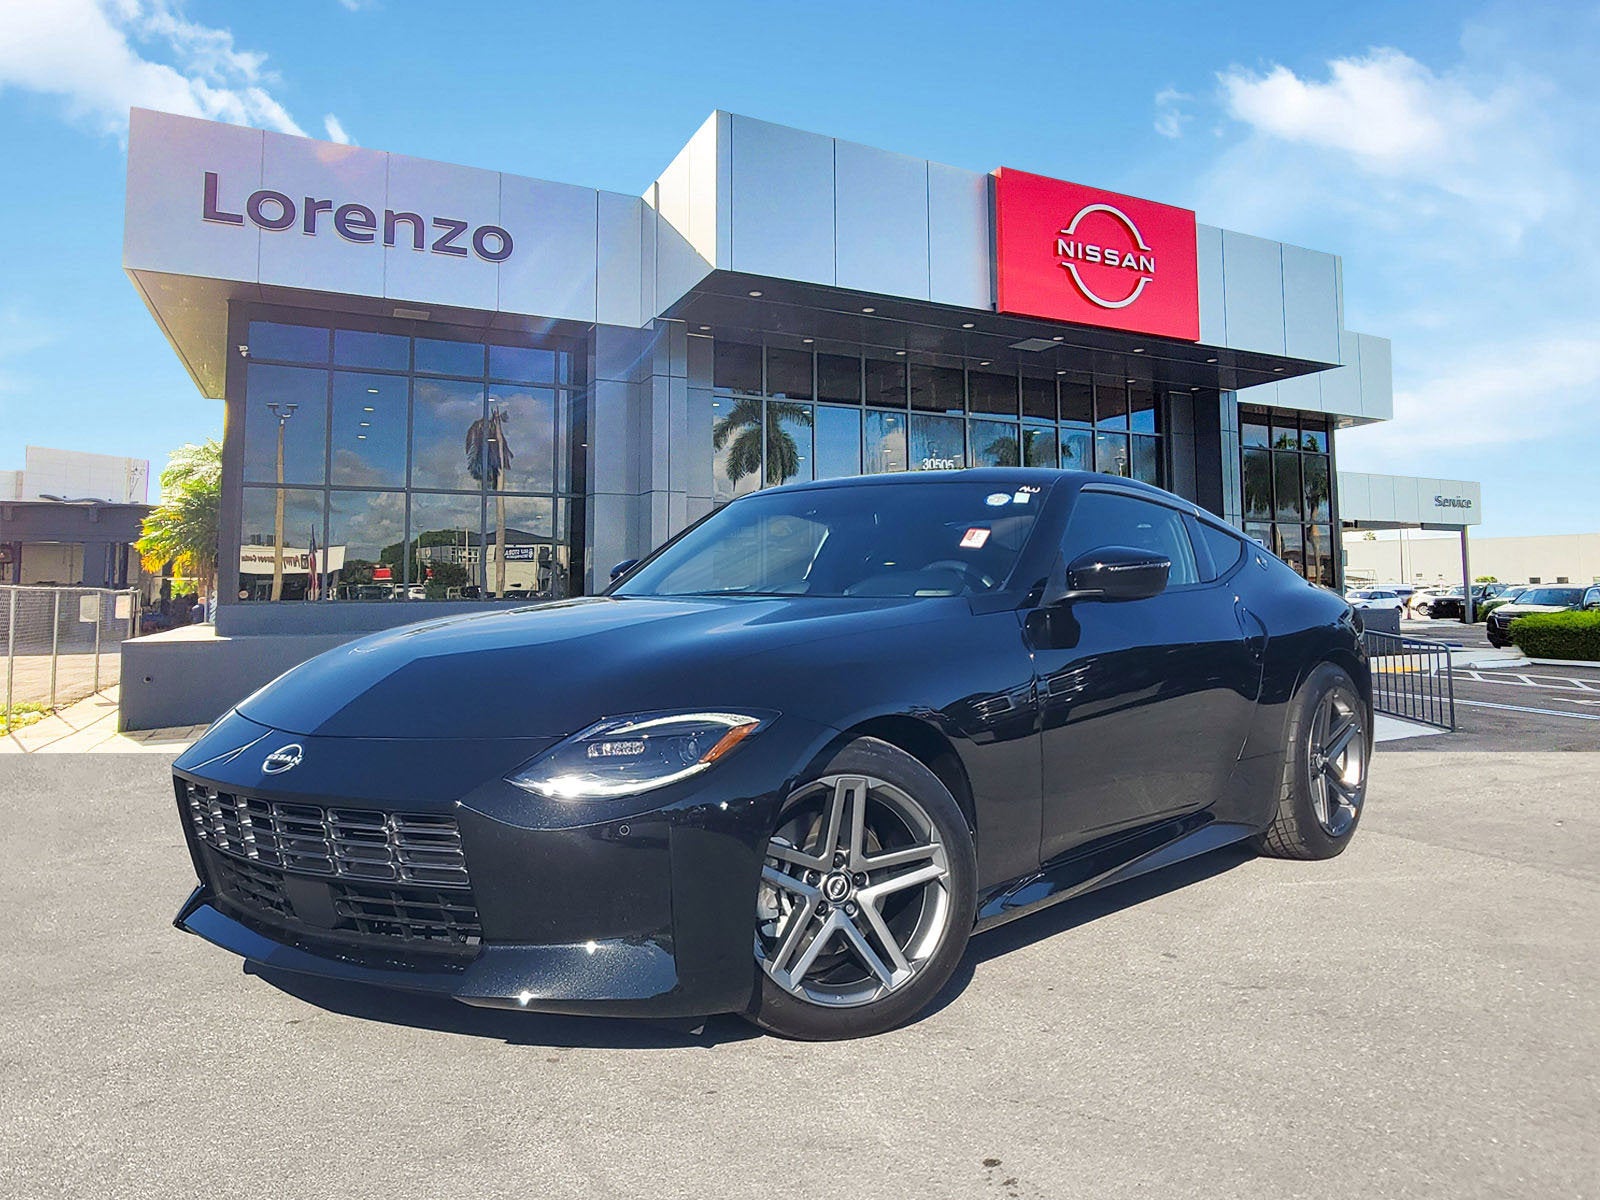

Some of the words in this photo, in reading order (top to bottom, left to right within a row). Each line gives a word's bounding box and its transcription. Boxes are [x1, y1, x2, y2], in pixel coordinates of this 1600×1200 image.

[202, 171, 514, 263] Lorenzo
[1056, 238, 1156, 274] NISSAN
[922, 457, 955, 470] 30505
[1434, 495, 1472, 509] Service
